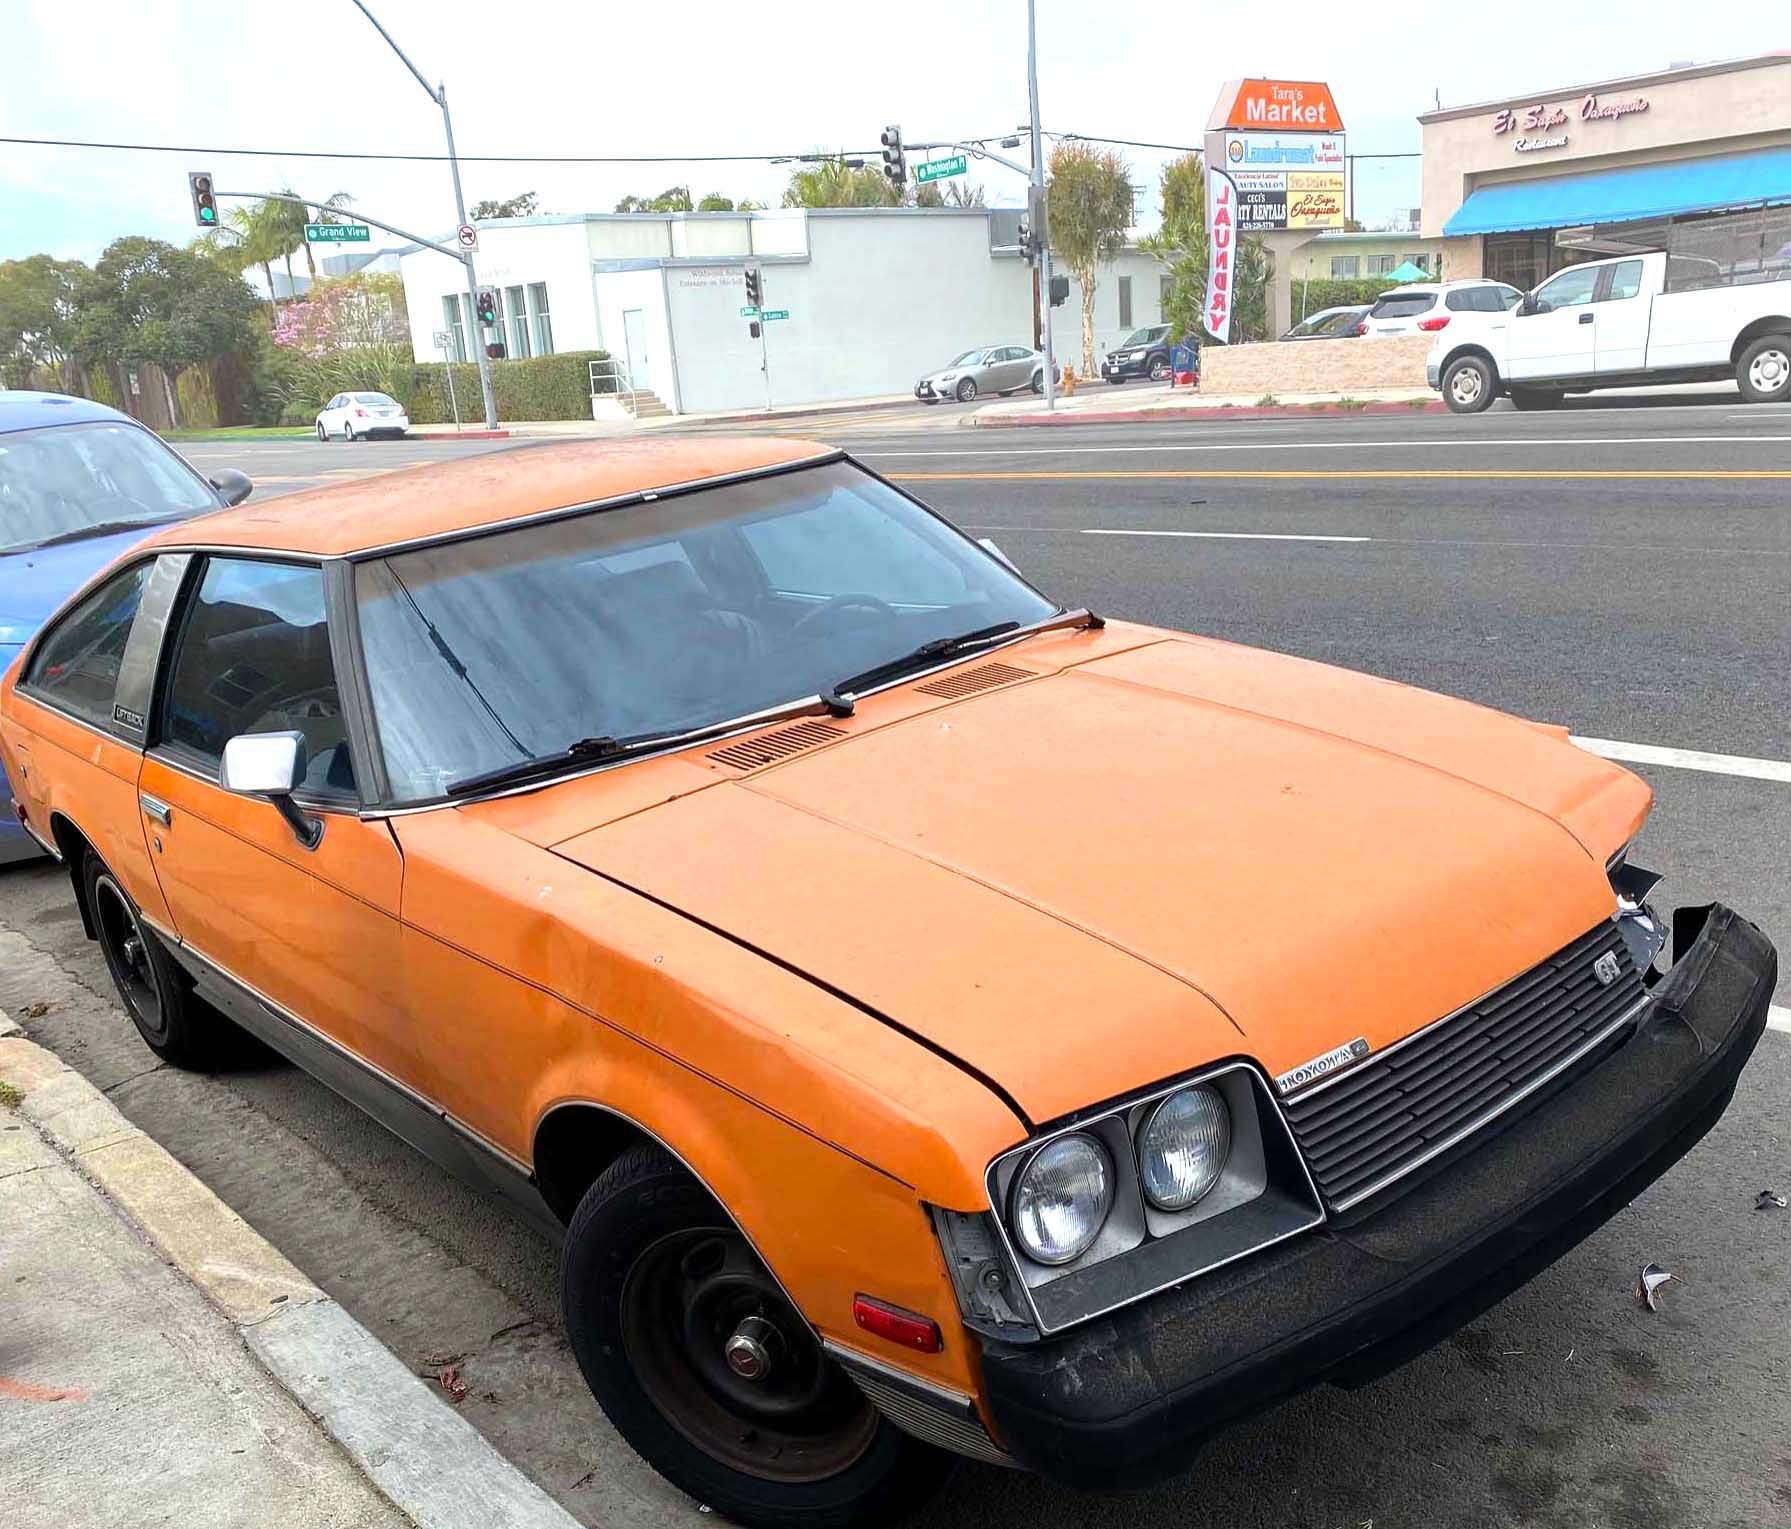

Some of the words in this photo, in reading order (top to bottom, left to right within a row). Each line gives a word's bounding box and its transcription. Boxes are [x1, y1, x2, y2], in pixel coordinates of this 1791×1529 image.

[1272, 86, 1304, 100] Tara's
[1246, 97, 1327, 123] Market
[1494, 109, 1516, 135] El
[1252, 203, 1286, 220] RENTALS
[319, 227, 345, 237] Grand
[346, 226, 367, 237] View
[1279, 1047, 1352, 1091] TOYOTA
